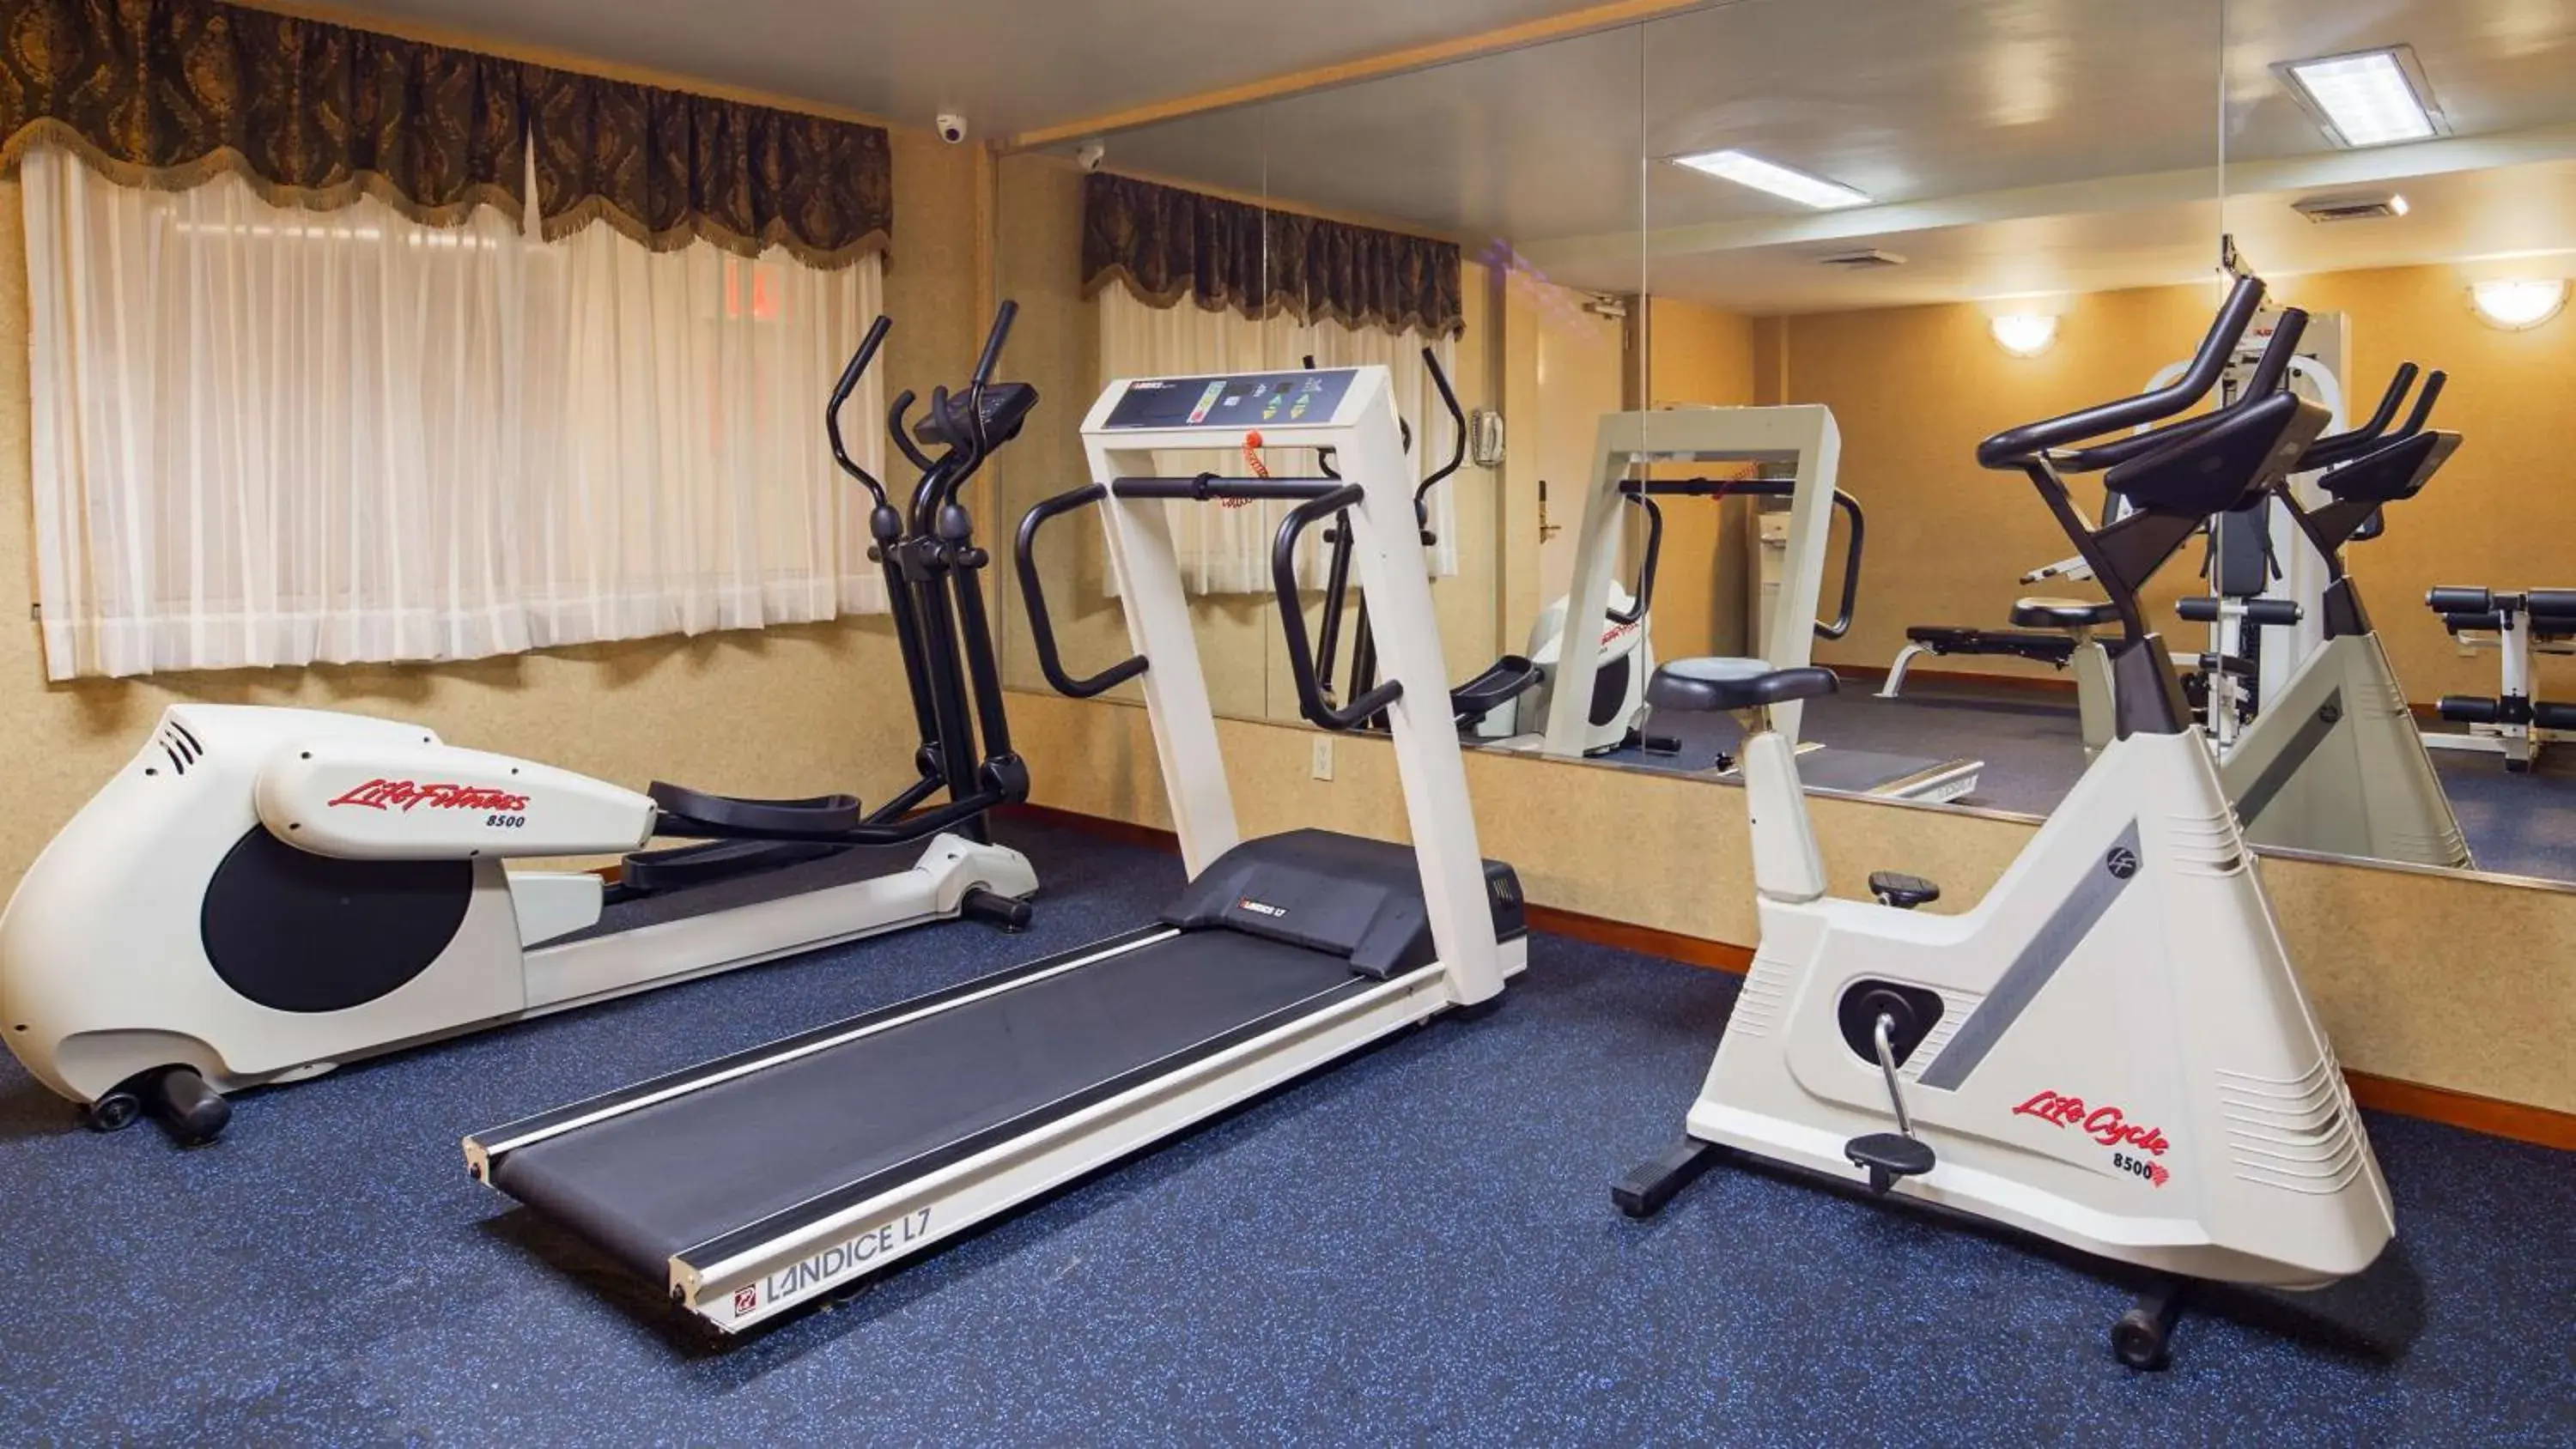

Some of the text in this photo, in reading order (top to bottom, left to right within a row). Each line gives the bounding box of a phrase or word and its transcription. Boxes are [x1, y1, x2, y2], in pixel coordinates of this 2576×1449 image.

[486, 815, 526, 828] 8500
[2113, 1153, 2153, 1179] 8500
[768, 1209, 930, 1303] LANDICE L7
